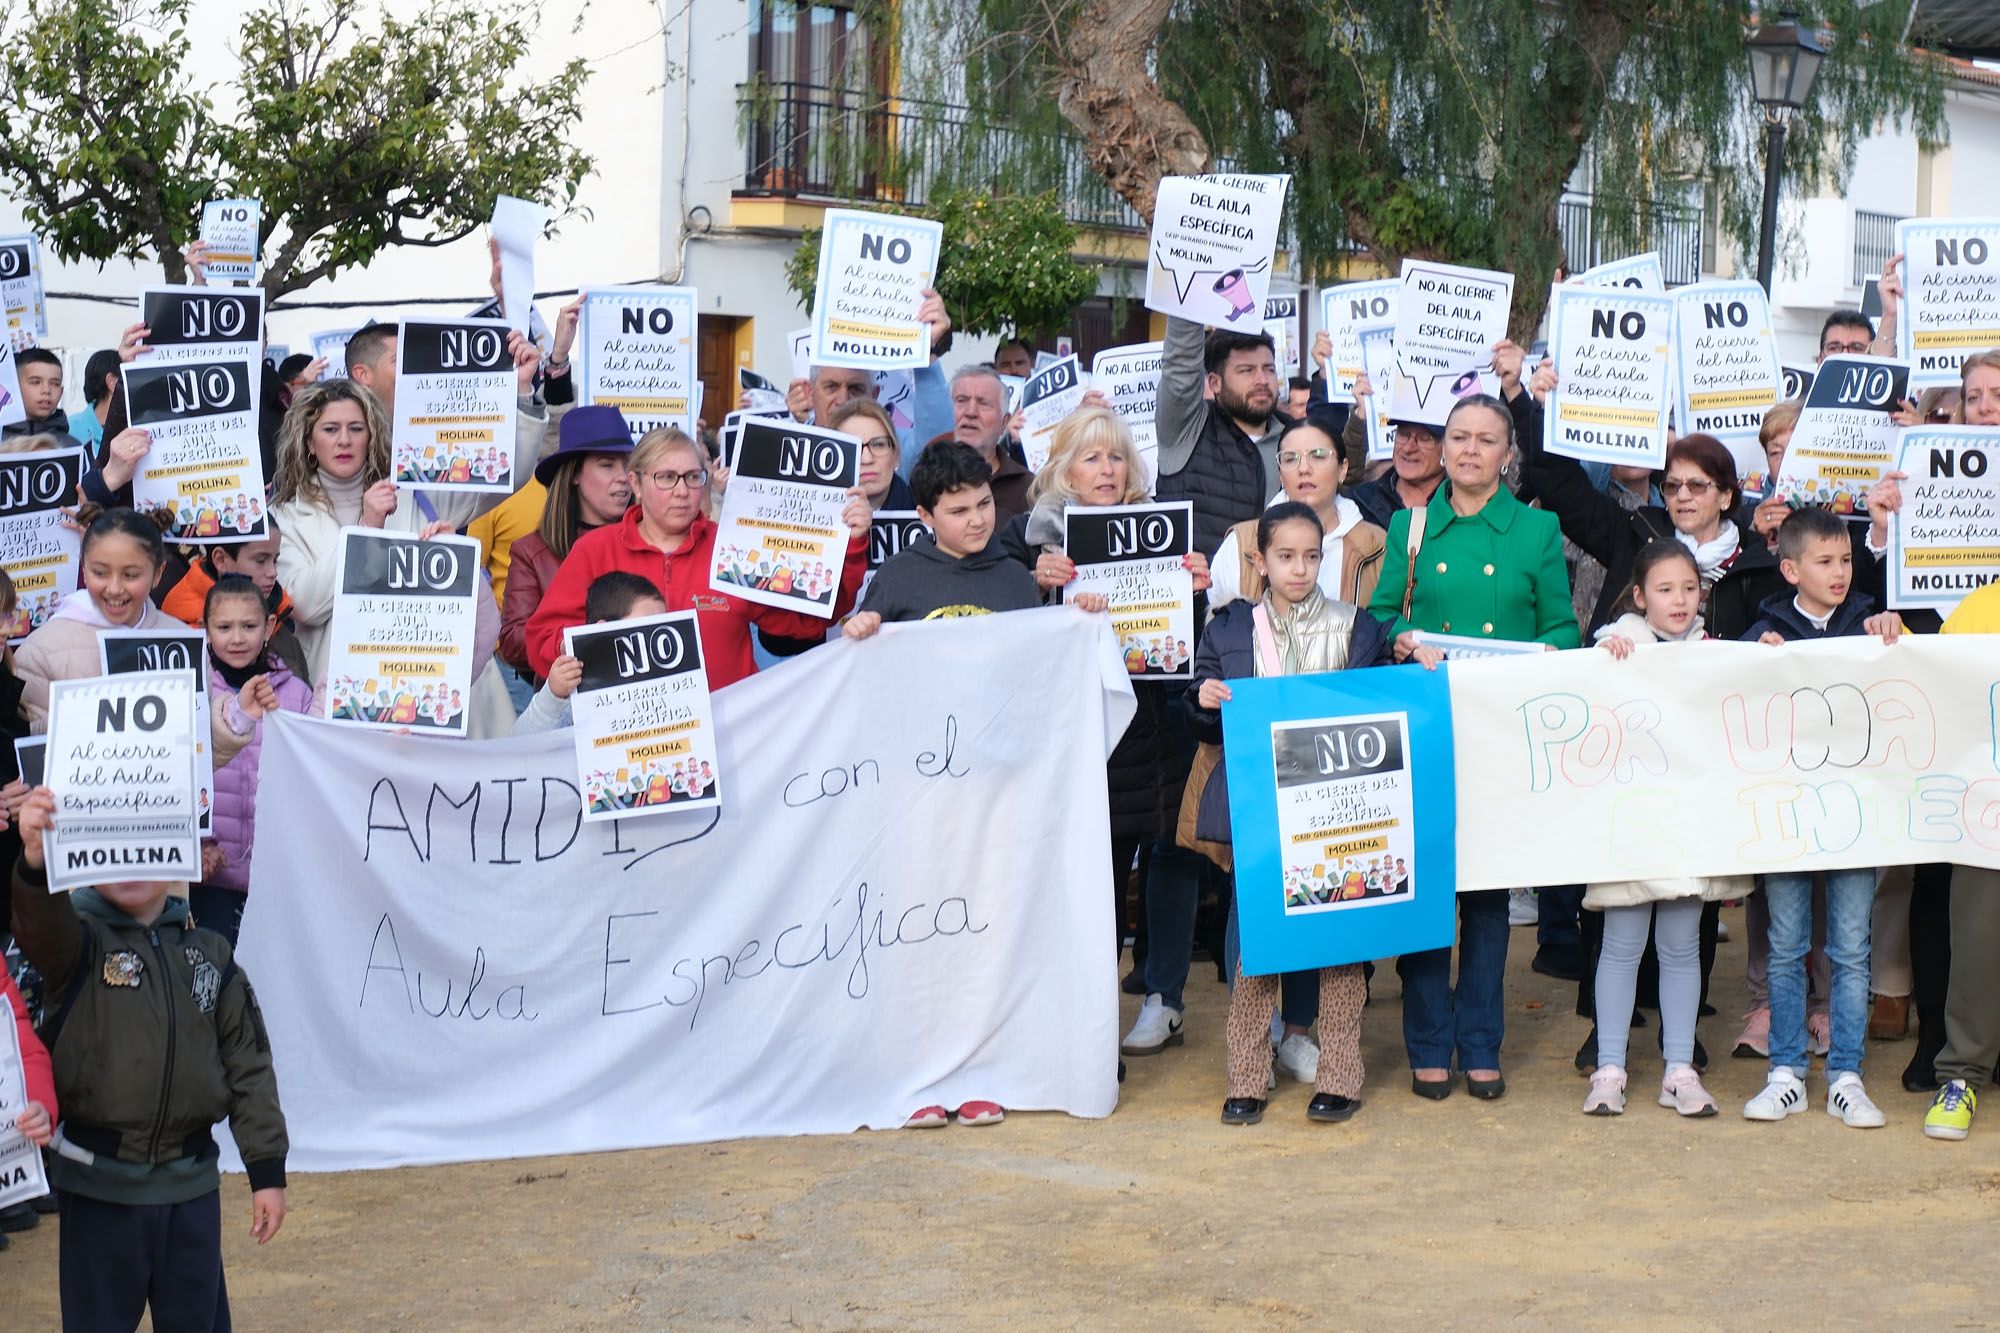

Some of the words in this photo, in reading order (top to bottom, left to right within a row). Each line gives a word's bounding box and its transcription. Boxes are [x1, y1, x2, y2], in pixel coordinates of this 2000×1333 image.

[1204, 175, 1220, 185] AL
[1222, 176, 1270, 194] CIERRE
[1190, 192, 1214, 209] DEL
[1216, 198, 1251, 216] AULA
[221, 209, 248, 222] NO
[860, 233, 911, 264] NO
[1170, 247, 1213, 265] MOLLINA
[1935, 238, 1988, 266] NO
[844, 263, 865, 279] Al
[867, 270, 915, 286] cierre
[1922, 273, 1944, 287] Al
[1946, 274, 1996, 287] cierre
[843, 281, 870, 298] del
[872, 287, 913, 304] Aula
[1418, 280, 1435, 293] NO
[1437, 283, 1451, 295] AL
[1454, 285, 1496, 301] CIERRE
[1923, 289, 1950, 304] del
[1953, 288, 1996, 303] Aula
[182, 297, 246, 338] NO
[836, 298, 918, 323] Específica
[1351, 297, 1389, 320] NO
[1427, 303, 1449, 317] DEL
[1451, 307, 1481, 322] AULA
[1704, 301, 1748, 329] NO
[622, 307, 673, 335] NO
[1591, 309, 1646, 340] NO
[441, 328, 501, 367] NO
[604, 338, 624, 354] Al
[627, 341, 677, 355] cierre
[833, 340, 913, 357] MOLLINA
[1695, 335, 1715, 350] Al
[1717, 334, 1759, 348] cierre
[604, 356, 631, 372] del
[634, 357, 675, 372] Aula
[1410, 355, 1450, 369] MOLLINA
[1576, 345, 1597, 360] Al
[1600, 347, 1651, 364] cierre
[1697, 353, 1722, 367] del
[1725, 351, 1761, 365] Aula
[1105, 364, 1119, 375] NO
[1120, 363, 1133, 374] AL
[1574, 362, 1602, 381] del
[1606, 366, 1648, 382] Aula
[167, 364, 235, 412] NO
[416, 379, 432, 390] AL
[435, 377, 480, 390] CIERRE
[485, 376, 507, 388] DEL
[599, 375, 681, 393] Específica
[1037, 364, 1070, 398] NO
[1694, 371, 1769, 388] Específica
[1838, 367, 1893, 405] NO
[446, 389, 477, 401] AULA
[1114, 384, 1135, 396] DEL
[1568, 382, 1654, 404] Específica
[169, 420, 217, 438] CIERRE
[221, 416, 247, 430] DEL
[1696, 413, 1761, 430] MOLLIN
[1810, 413, 1823, 424] AL
[1825, 412, 1867, 426] CIERRE
[182, 434, 216, 449] AULA
[440, 430, 486, 440] MOLLINA
[1565, 428, 1650, 450] MOLLINA
[1833, 426, 1864, 438] AULA
[779, 436, 845, 481] NO
[1930, 449, 1988, 478] NO
[1823, 466, 1871, 476] MOLLINA
[0, 461, 66, 511] NO
[182, 477, 232, 492] MOLLINA
[749, 482, 765, 495] AL
[770, 484, 817, 501] CIERRE
[822, 489, 847, 504] DEL
[1915, 485, 1937, 500] Al
[1941, 486, 1995, 500] cierre
[779, 498, 813, 512] AULA
[1915, 503, 1945, 519] del
[1949, 503, 1995, 518] Aula
[767, 536, 815, 552] MOLLINA
[1107, 513, 1174, 556] NO
[388, 545, 458, 590] NO
[1082, 567, 1098, 581] AL
[1102, 562, 1152, 579] CIERRE
[1157, 559, 1181, 573] DEL
[1115, 576, 1150, 590] AULA
[358, 600, 375, 614] AL
[381, 600, 432, 614] CIERRE
[438, 601, 463, 615] DEL
[393, 615, 428, 628] AULA
[1112, 618, 1161, 632] MOLLINA
[614, 625, 684, 678] NO
[383, 663, 436, 673] MOLLINA
[594, 694, 613, 708] AL
[617, 681, 667, 703] CIERRE
[671, 676, 697, 692] DEL
[97, 695, 167, 733] NO
[631, 697, 667, 715] AULA
[1516, 692, 1670, 793] POR
[1721, 678, 1937, 774] UNA
[70, 743, 97, 761] Al
[102, 742, 171, 761] cierre
[631, 741, 683, 759] MOLLINA
[1314, 725, 1387, 774] NO
[69, 766, 107, 787] del
[112, 765, 171, 786] Aula
[365, 777, 721, 870] AMID
[784, 758, 880, 808] con
[916, 715, 970, 779] el
[1294, 790, 1311, 803] AL
[1317, 781, 1366, 801] CIERRE
[1371, 776, 1398, 791] DEL
[64, 791, 181, 816] Específica
[1330, 794, 1366, 811] AULA
[1329, 839, 1380, 855] MOLLINA
[68, 846, 183, 869] MOLLINA
[360, 912, 538, 1021] Aula
